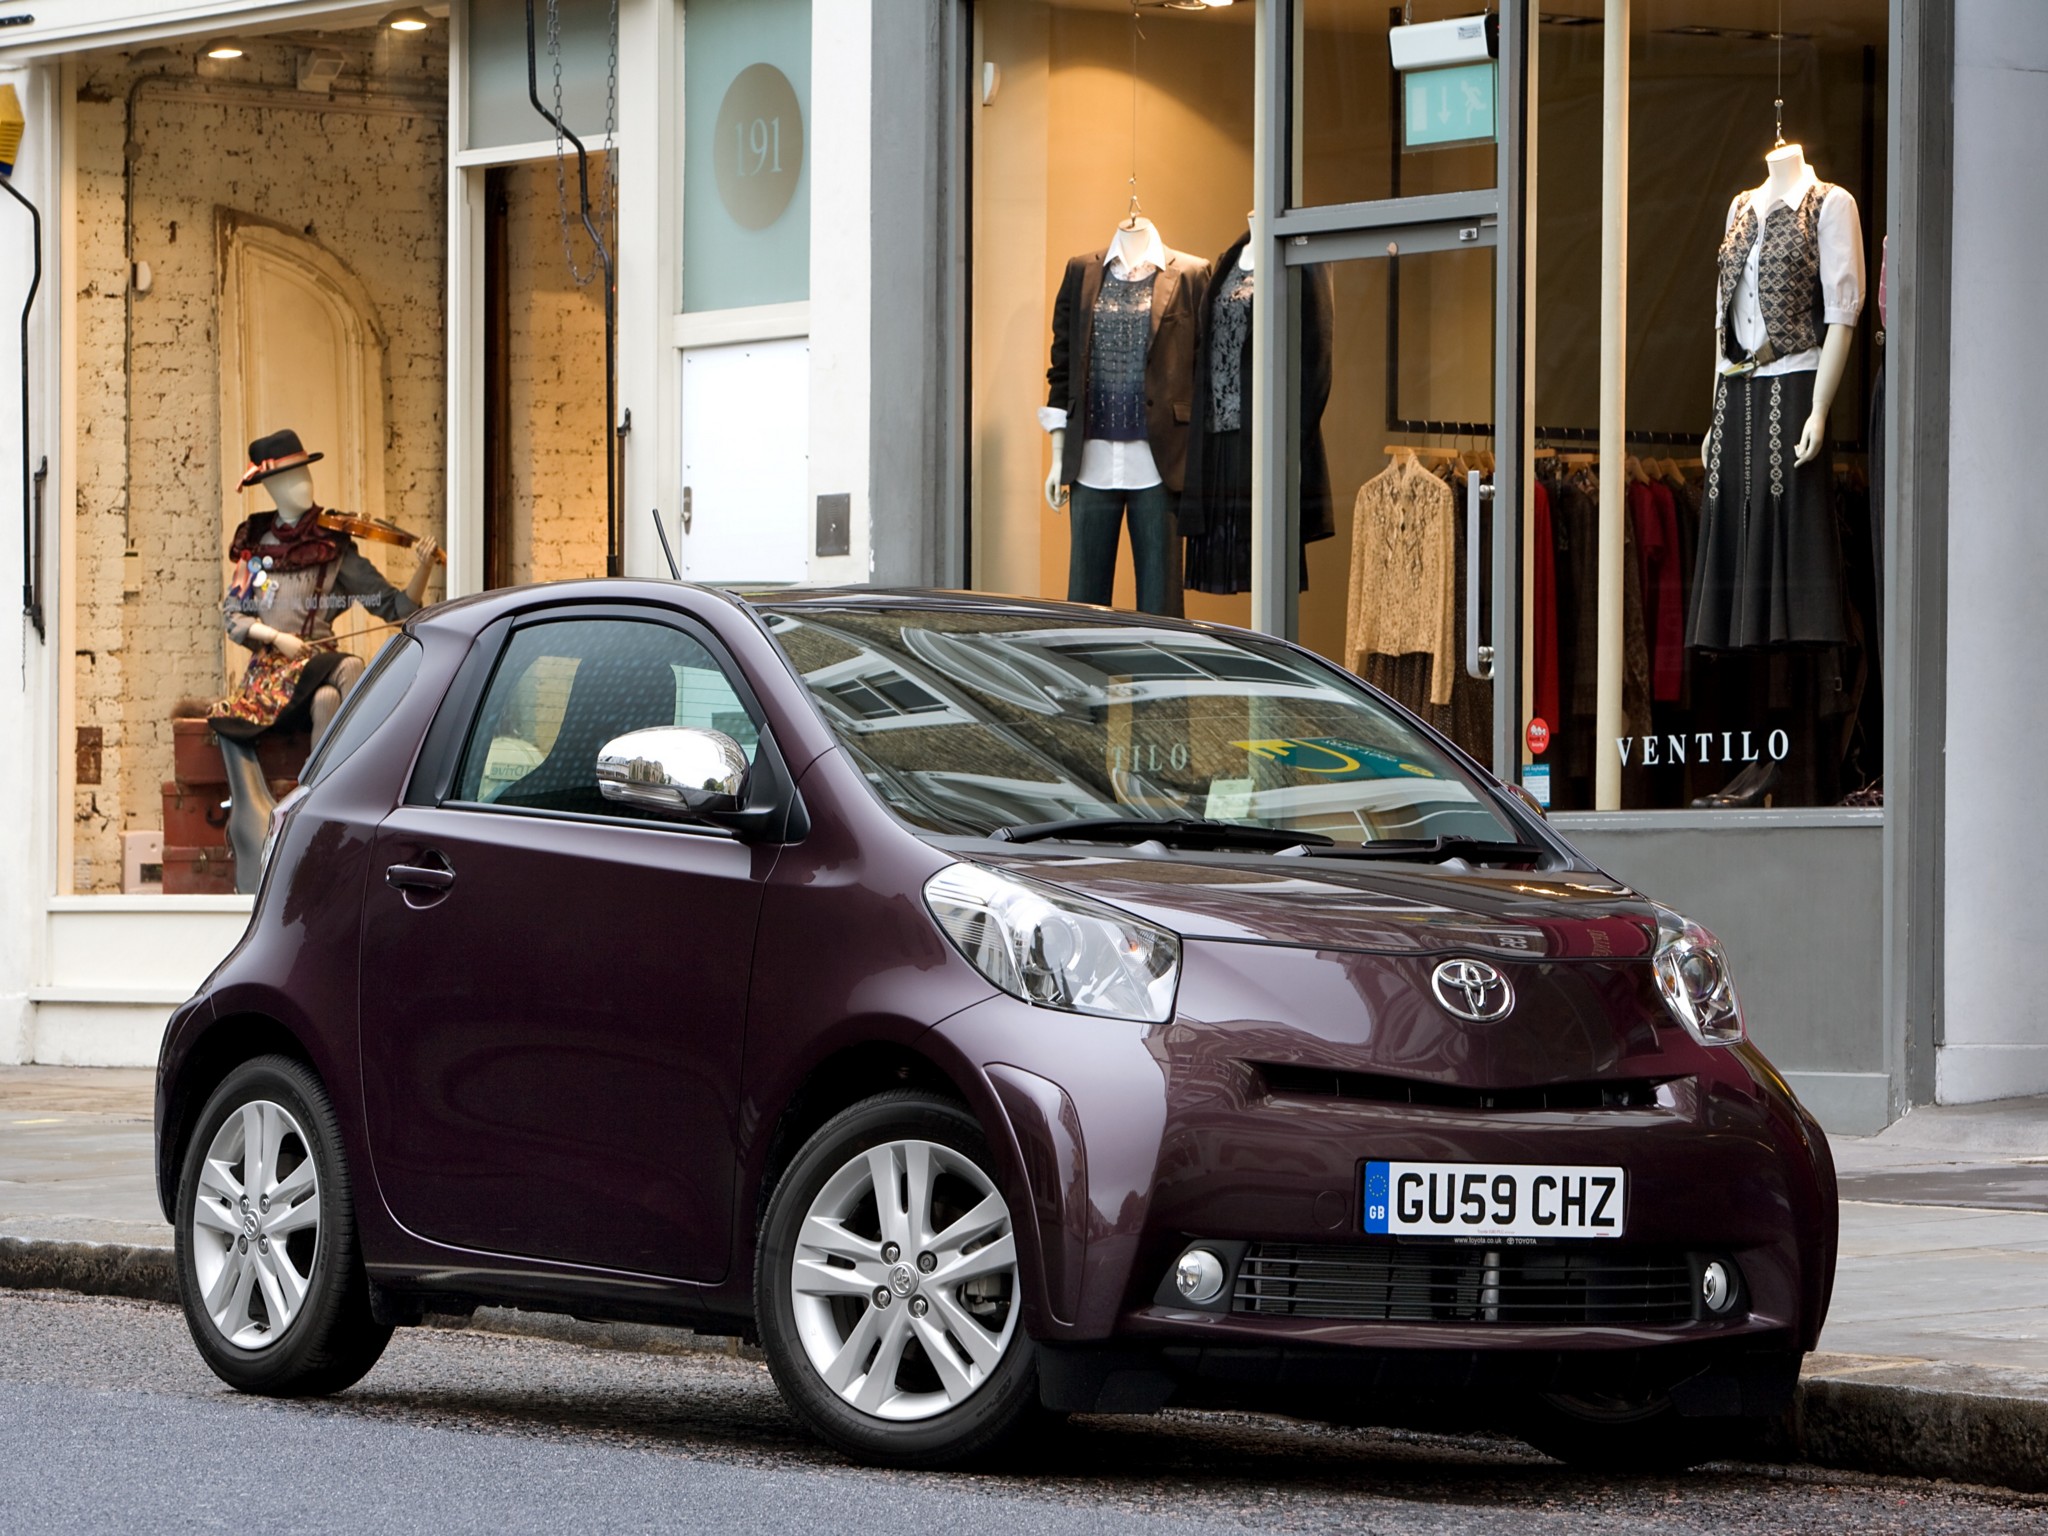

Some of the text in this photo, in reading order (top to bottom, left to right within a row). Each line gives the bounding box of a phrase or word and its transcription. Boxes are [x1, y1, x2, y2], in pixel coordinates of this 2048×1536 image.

[735, 116, 783, 177] 191
[1099, 743, 1188, 771] TILO
[1615, 729, 1790, 767] VENTILO
[1369, 1205, 1385, 1220] GB
[1397, 1172, 1616, 1227] GU59 CHZ
[1453, 1237, 1502, 1246] www.toyota.co.uk
